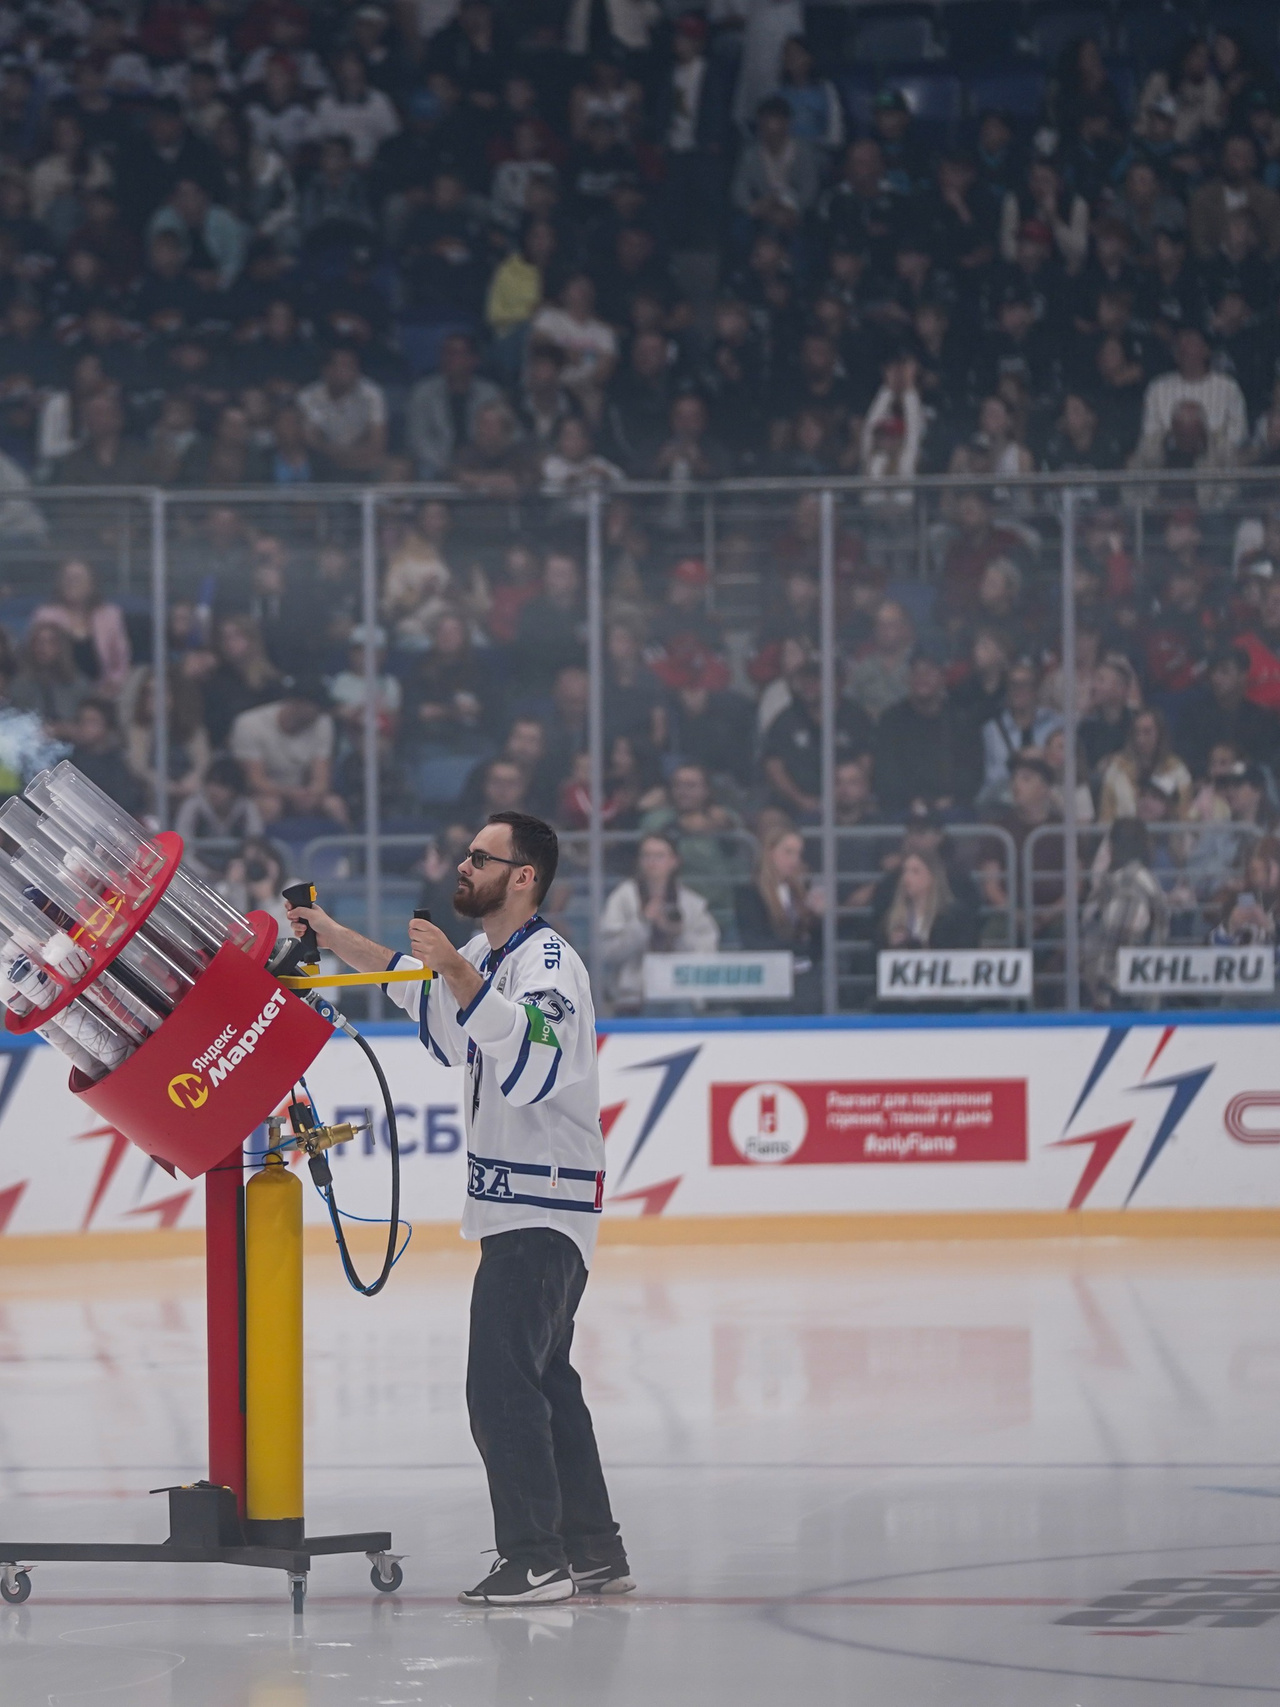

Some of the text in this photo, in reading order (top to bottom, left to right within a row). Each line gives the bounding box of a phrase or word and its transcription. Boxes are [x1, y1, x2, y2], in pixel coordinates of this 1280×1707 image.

[889, 957, 1022, 988] KHL.RU
[1128, 955, 1264, 984] KHL.RU
[191, 1023, 238, 1073] Яндекс
[208, 987, 287, 1088] Маркет
[334, 1103, 462, 1156] ПСБ
